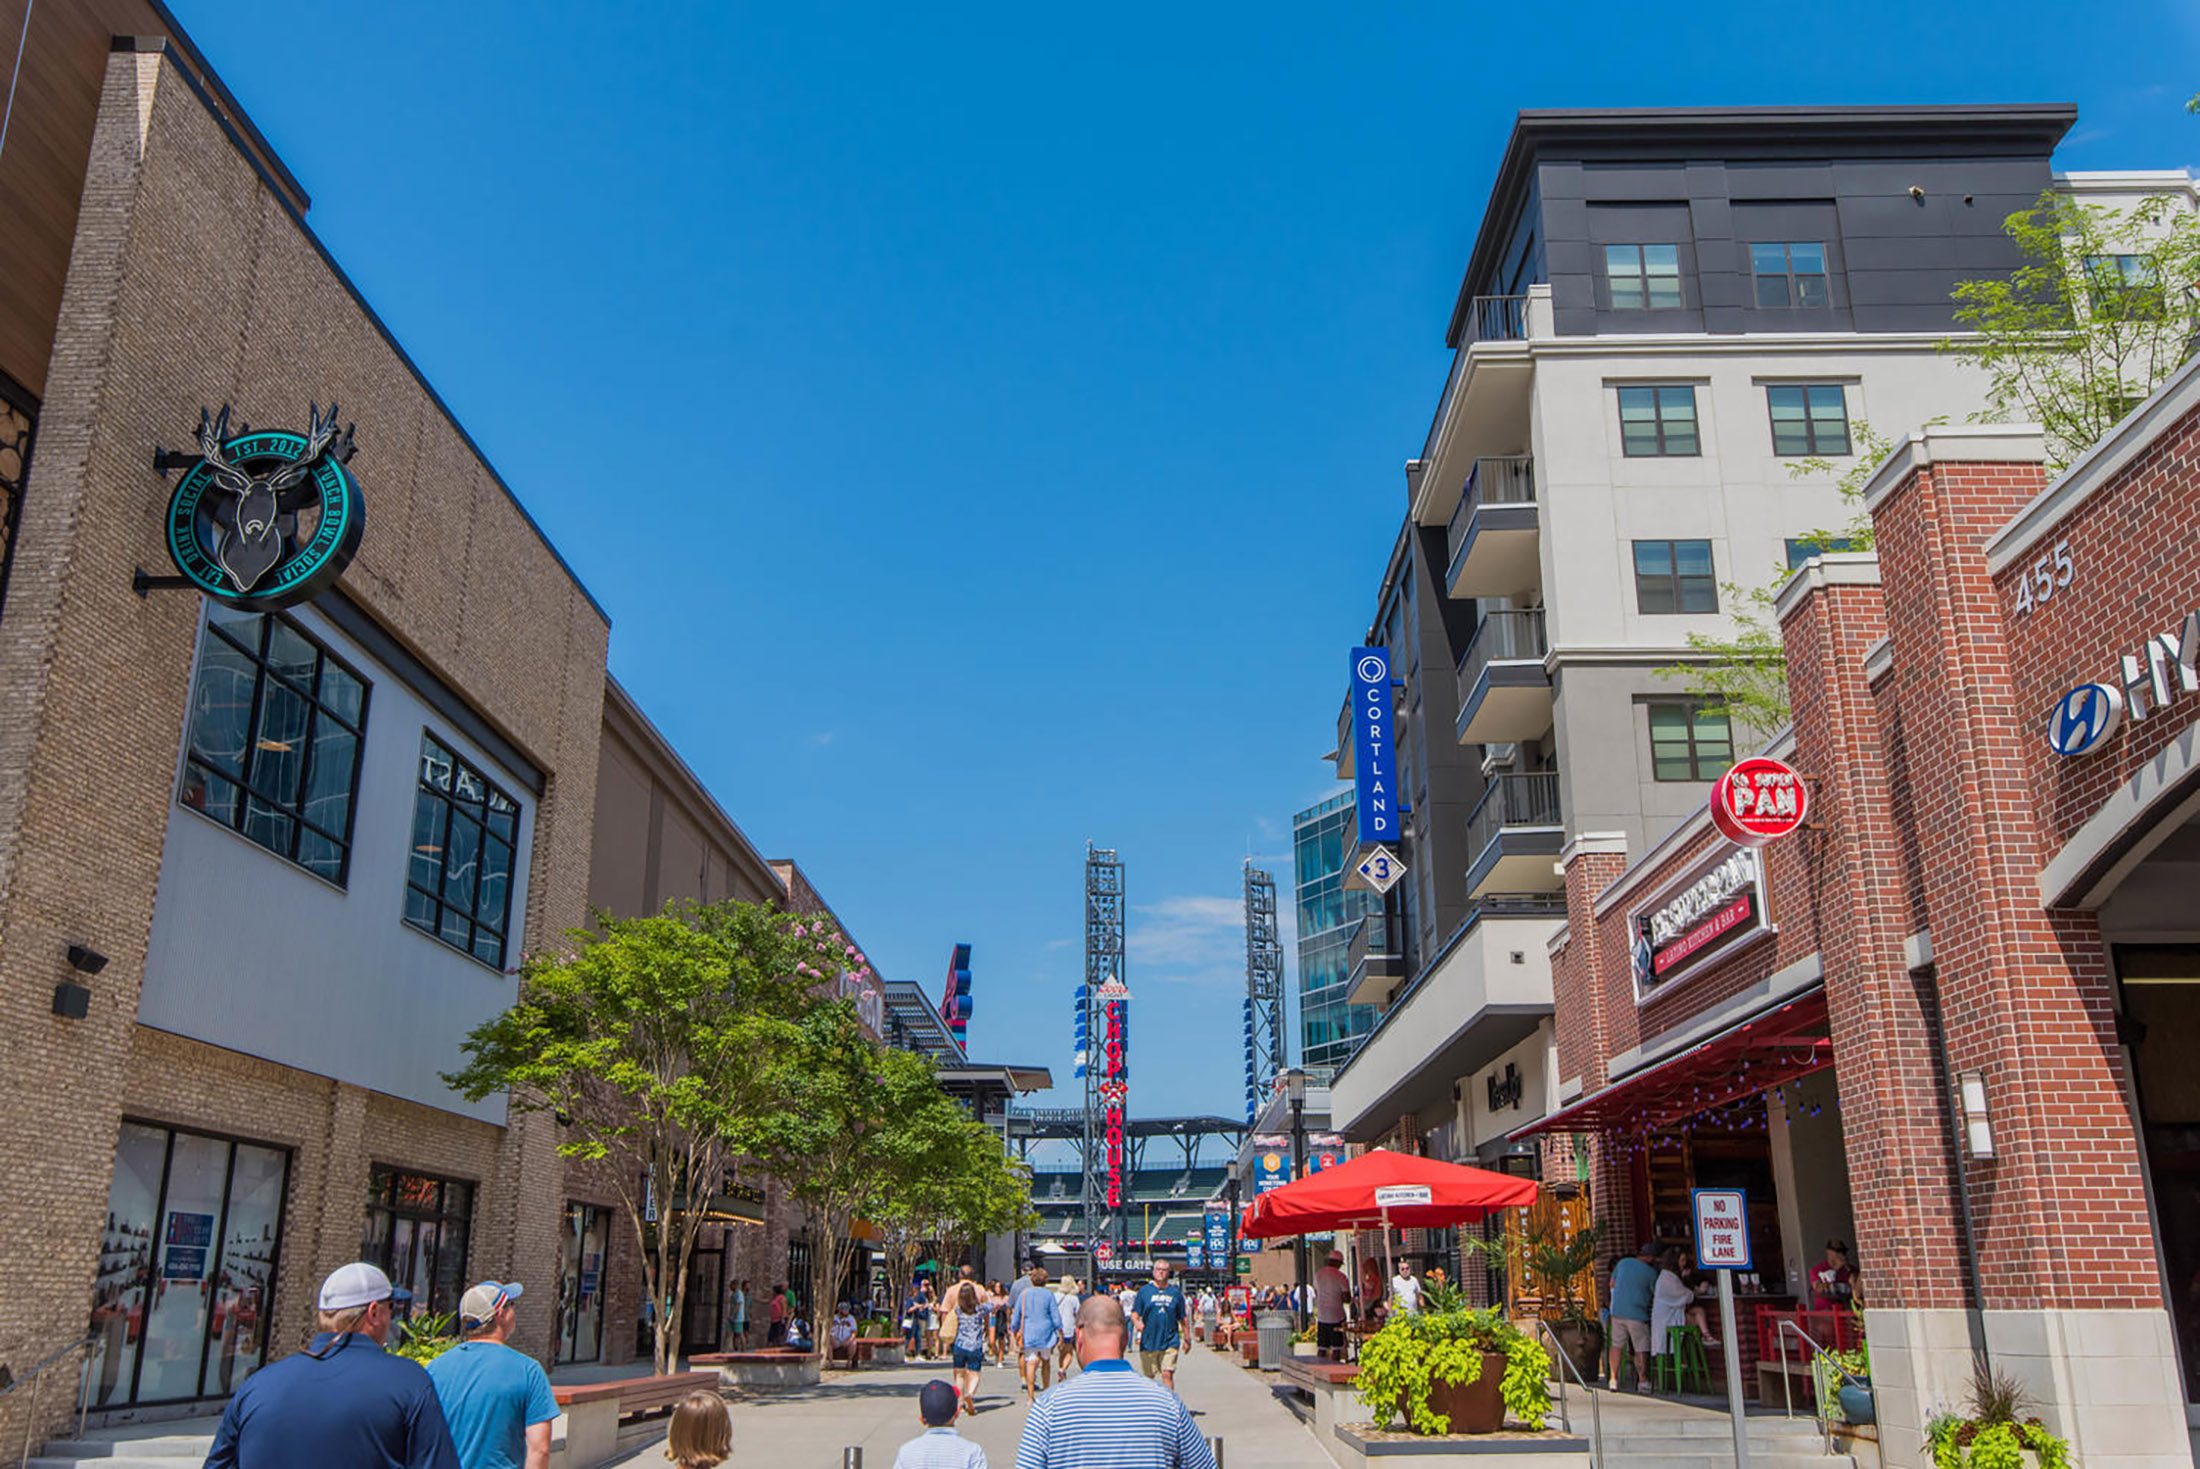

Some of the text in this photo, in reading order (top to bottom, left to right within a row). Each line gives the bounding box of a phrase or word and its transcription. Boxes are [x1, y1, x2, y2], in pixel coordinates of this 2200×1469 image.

[269, 438, 305, 457] 2012
[175, 471, 225, 585] EAT DRINK SOCIAL
[276, 464, 342, 585] PUNCH BOWL SOCIAL
[2015, 540, 2073, 614] 455
[2120, 608, 2200, 721] HY
[1366, 688, 1387, 831] CORTLAND
[1733, 787, 1797, 816] PAN
[1374, 857, 1390, 880] 3
[1665, 938, 1688, 964] LATINO
[1687, 923, 1714, 949] KITCHEN
[1721, 908, 1735, 929] BAR
[1106, 1002, 1122, 1078] CHOP
[1106, 1108, 1122, 1207] HOUSE
[1703, 1217, 1739, 1230] PARKING
[1713, 1200, 1726, 1213] NO
[1712, 1234, 1733, 1245] FIRE
[1712, 1247, 1736, 1258] LANE
[1124, 1260, 1152, 1270] GATE
